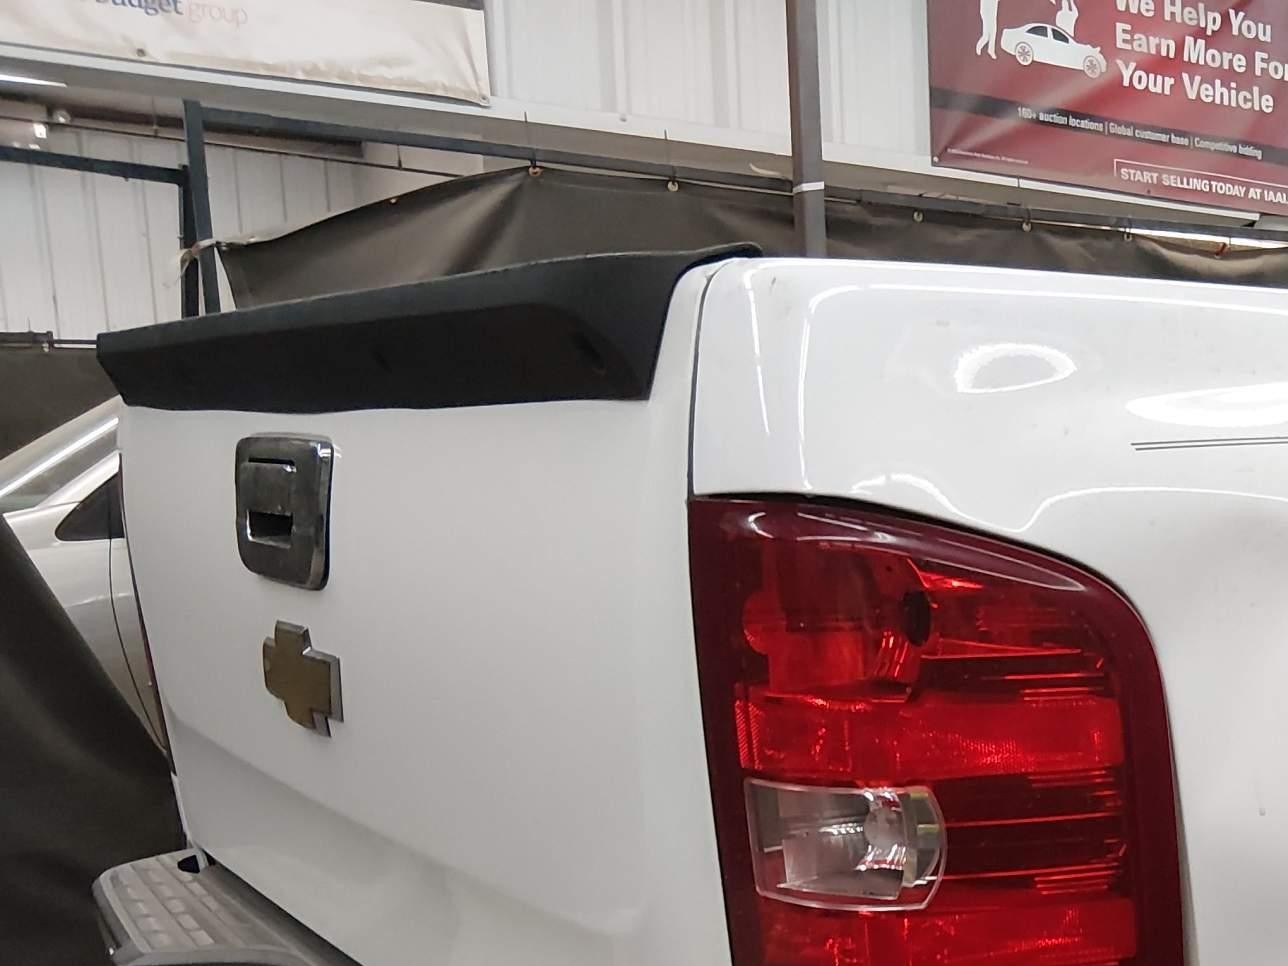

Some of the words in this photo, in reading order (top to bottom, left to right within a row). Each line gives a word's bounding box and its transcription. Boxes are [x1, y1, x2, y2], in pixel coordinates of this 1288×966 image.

[1164, 0, 1222, 36] Help
[1228, 9, 1272, 43] You
[1115, 22, 1176, 59] Earn
[1183, 36, 1247, 73] More
[1116, 59, 1175, 95] Your
[1182, 72, 1274, 113] Vehicle
[1039, 112, 1068, 125] auction
[1068, 115, 1104, 132] locations
[1109, 122, 1134, 137] Global
[1135, 129, 1170, 143] customer
[1171, 133, 1189, 146] base
[1194, 137, 1238, 154] Competitive
[1120, 168, 1159, 184] START
[1161, 174, 1210, 192] SELLING
[1210, 181, 1247, 197] TODAY
[1248, 187, 1263, 200] AT
